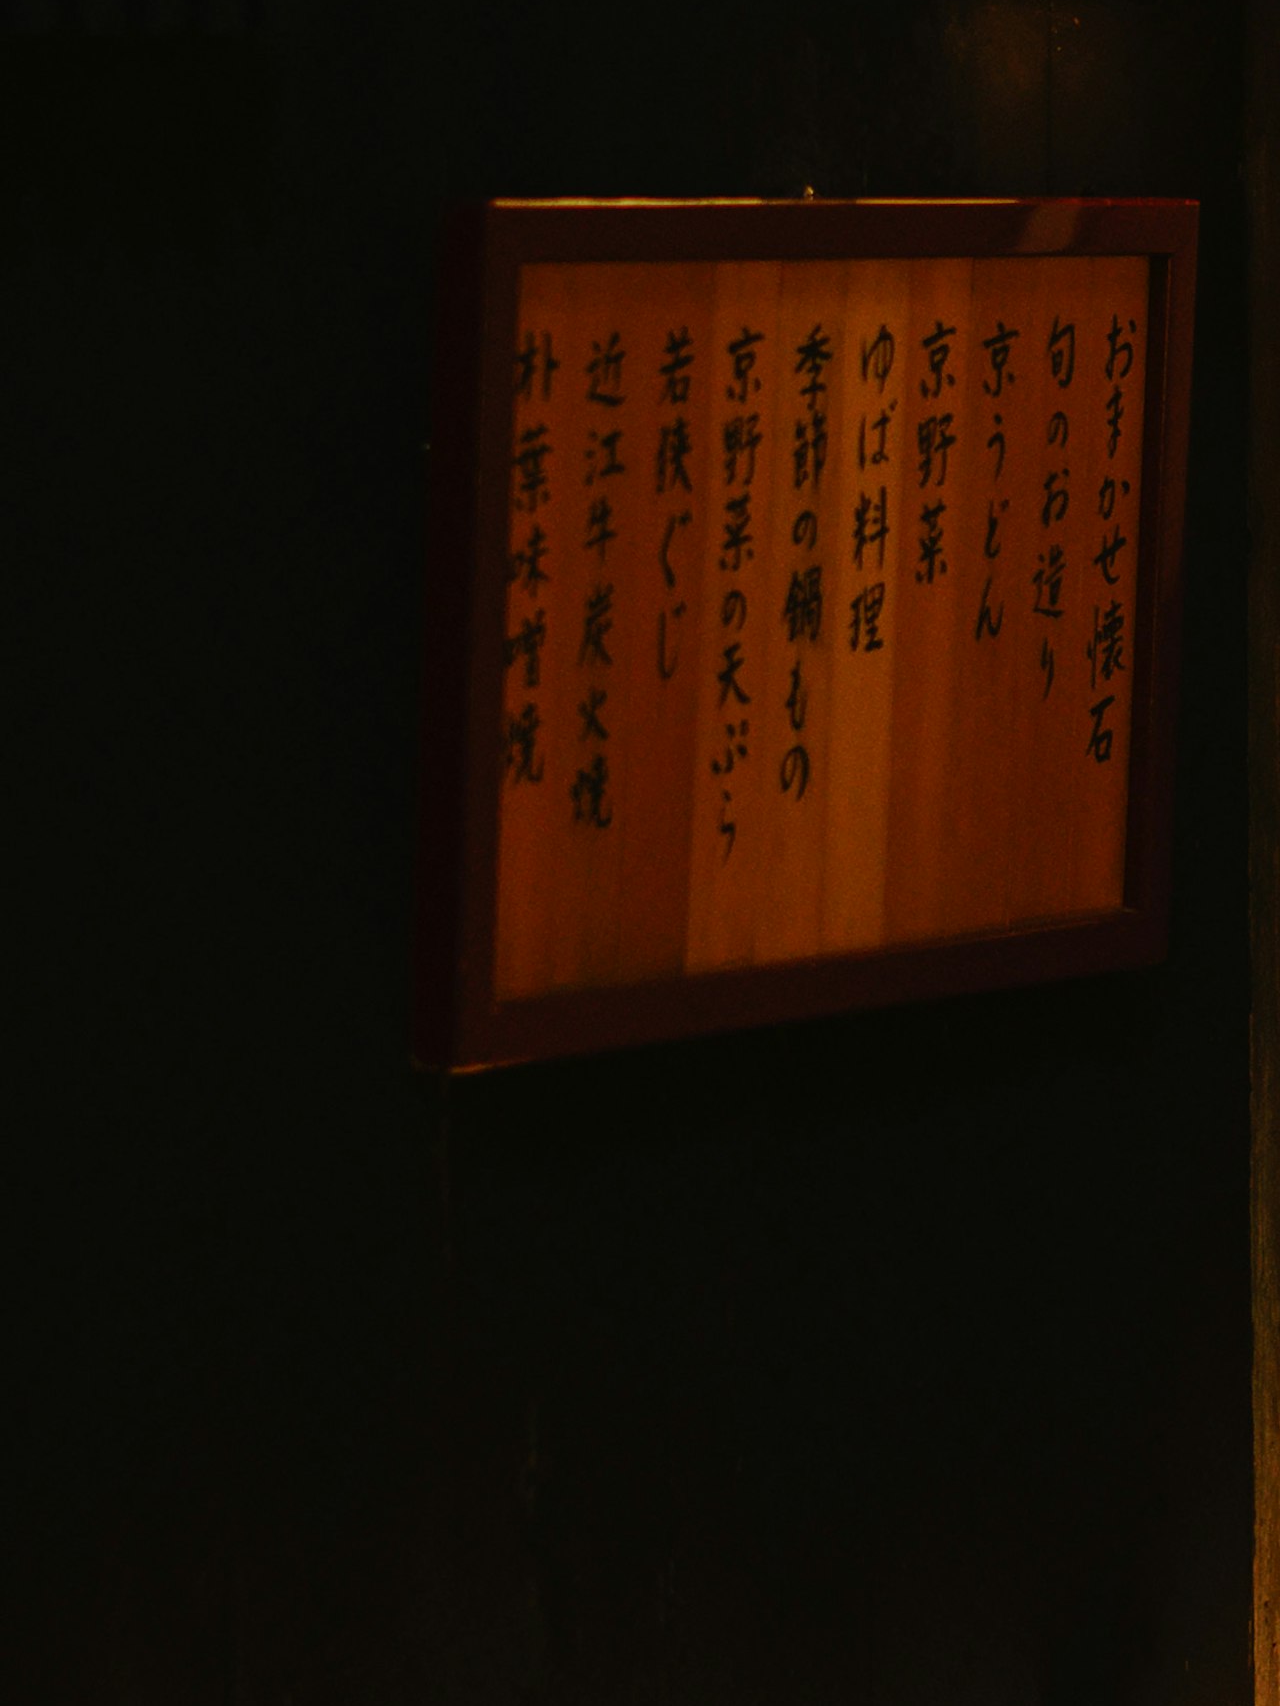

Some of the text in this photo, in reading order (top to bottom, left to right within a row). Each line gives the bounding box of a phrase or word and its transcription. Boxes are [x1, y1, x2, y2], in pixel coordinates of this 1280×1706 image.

[654, 321, 698, 682] 若狭ぐじ
[778, 321, 834, 803] 季節の鍋もの
[848, 324, 898, 653] ゆば料理
[915, 319, 959, 586] 京野菜
[974, 319, 1021, 645] 京うどん
[1030, 314, 1078, 704] 旬のお造り
[1085, 317, 1140, 767] おまかせ懐石
